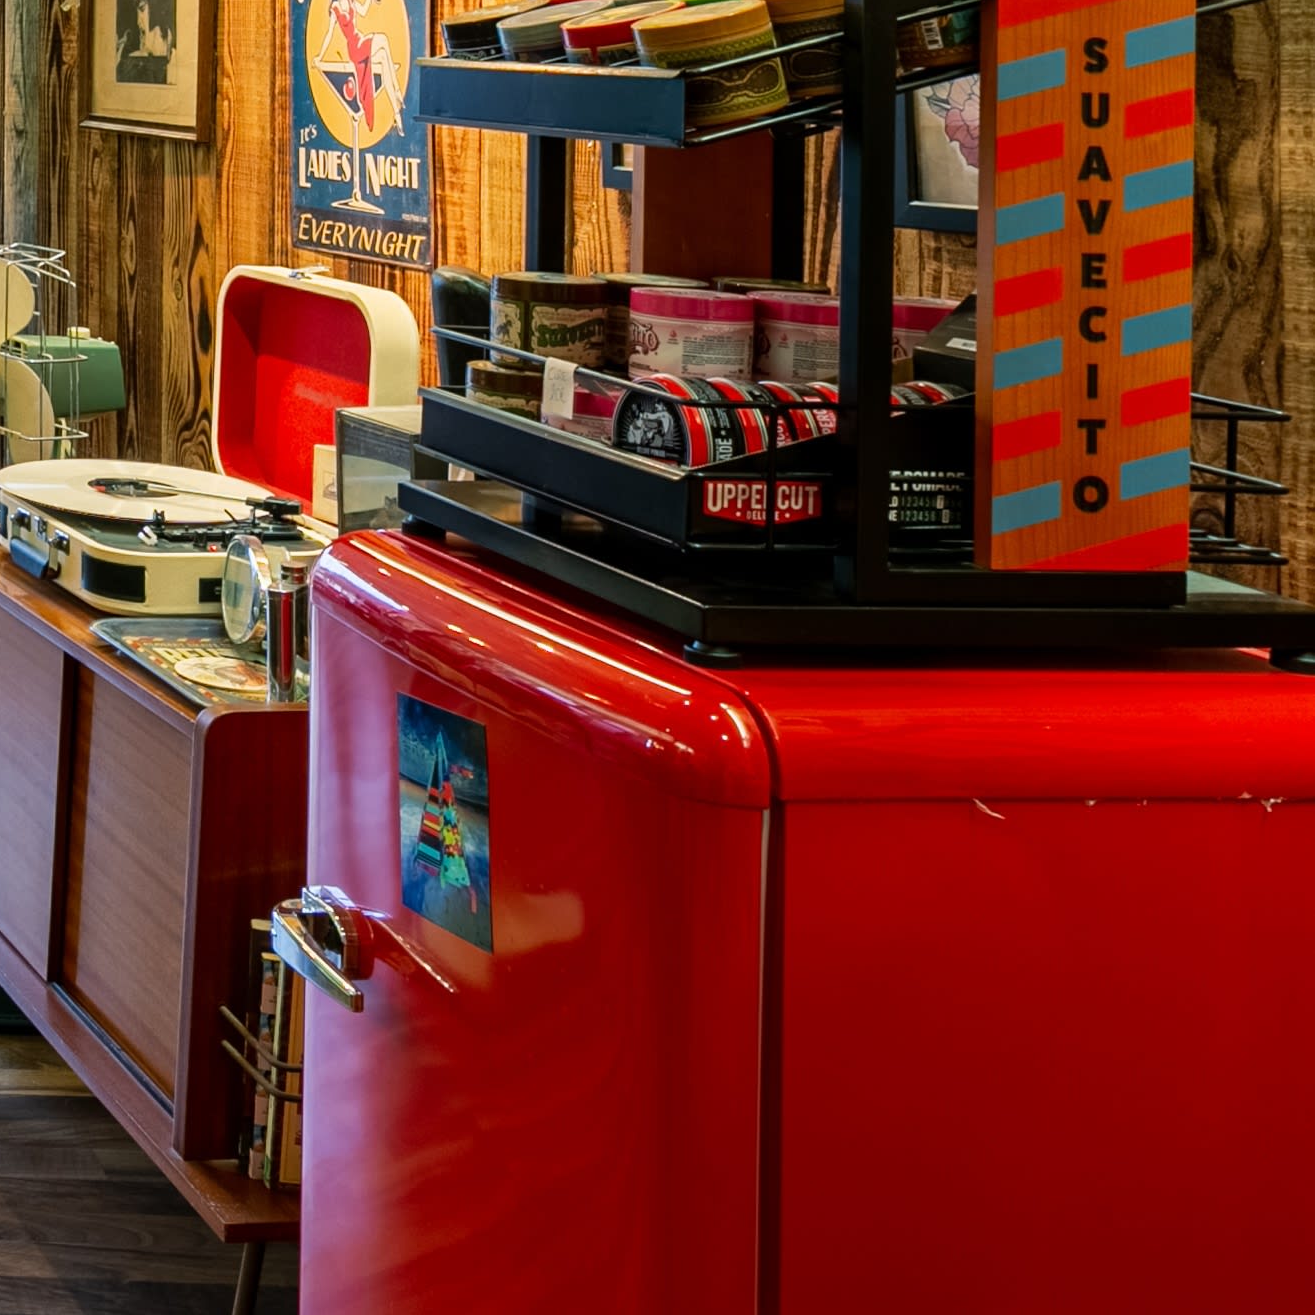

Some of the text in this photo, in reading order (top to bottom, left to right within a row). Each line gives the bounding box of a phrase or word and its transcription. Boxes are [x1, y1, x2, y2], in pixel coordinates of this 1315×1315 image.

[298, 146, 421, 198] LADIES NIGHT
[298, 212, 427, 261] EVERYNIGHT
[1073, 36, 1113, 514] SUAVECITO
